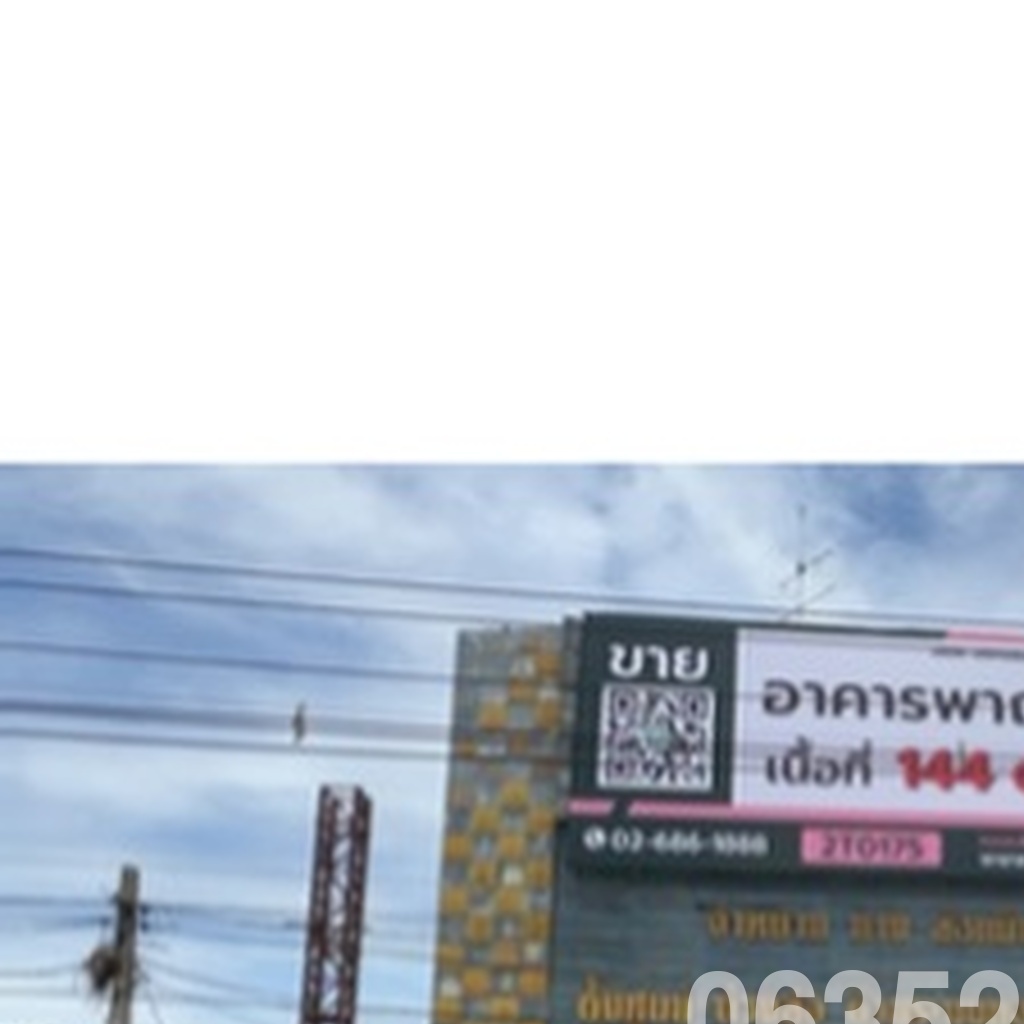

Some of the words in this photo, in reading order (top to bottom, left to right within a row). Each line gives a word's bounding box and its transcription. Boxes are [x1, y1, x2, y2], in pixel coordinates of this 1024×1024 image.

[609, 643, 710, 681] ขาย
[765, 736, 873, 788] เนื้อที่
[897, 746, 997, 792] 144
